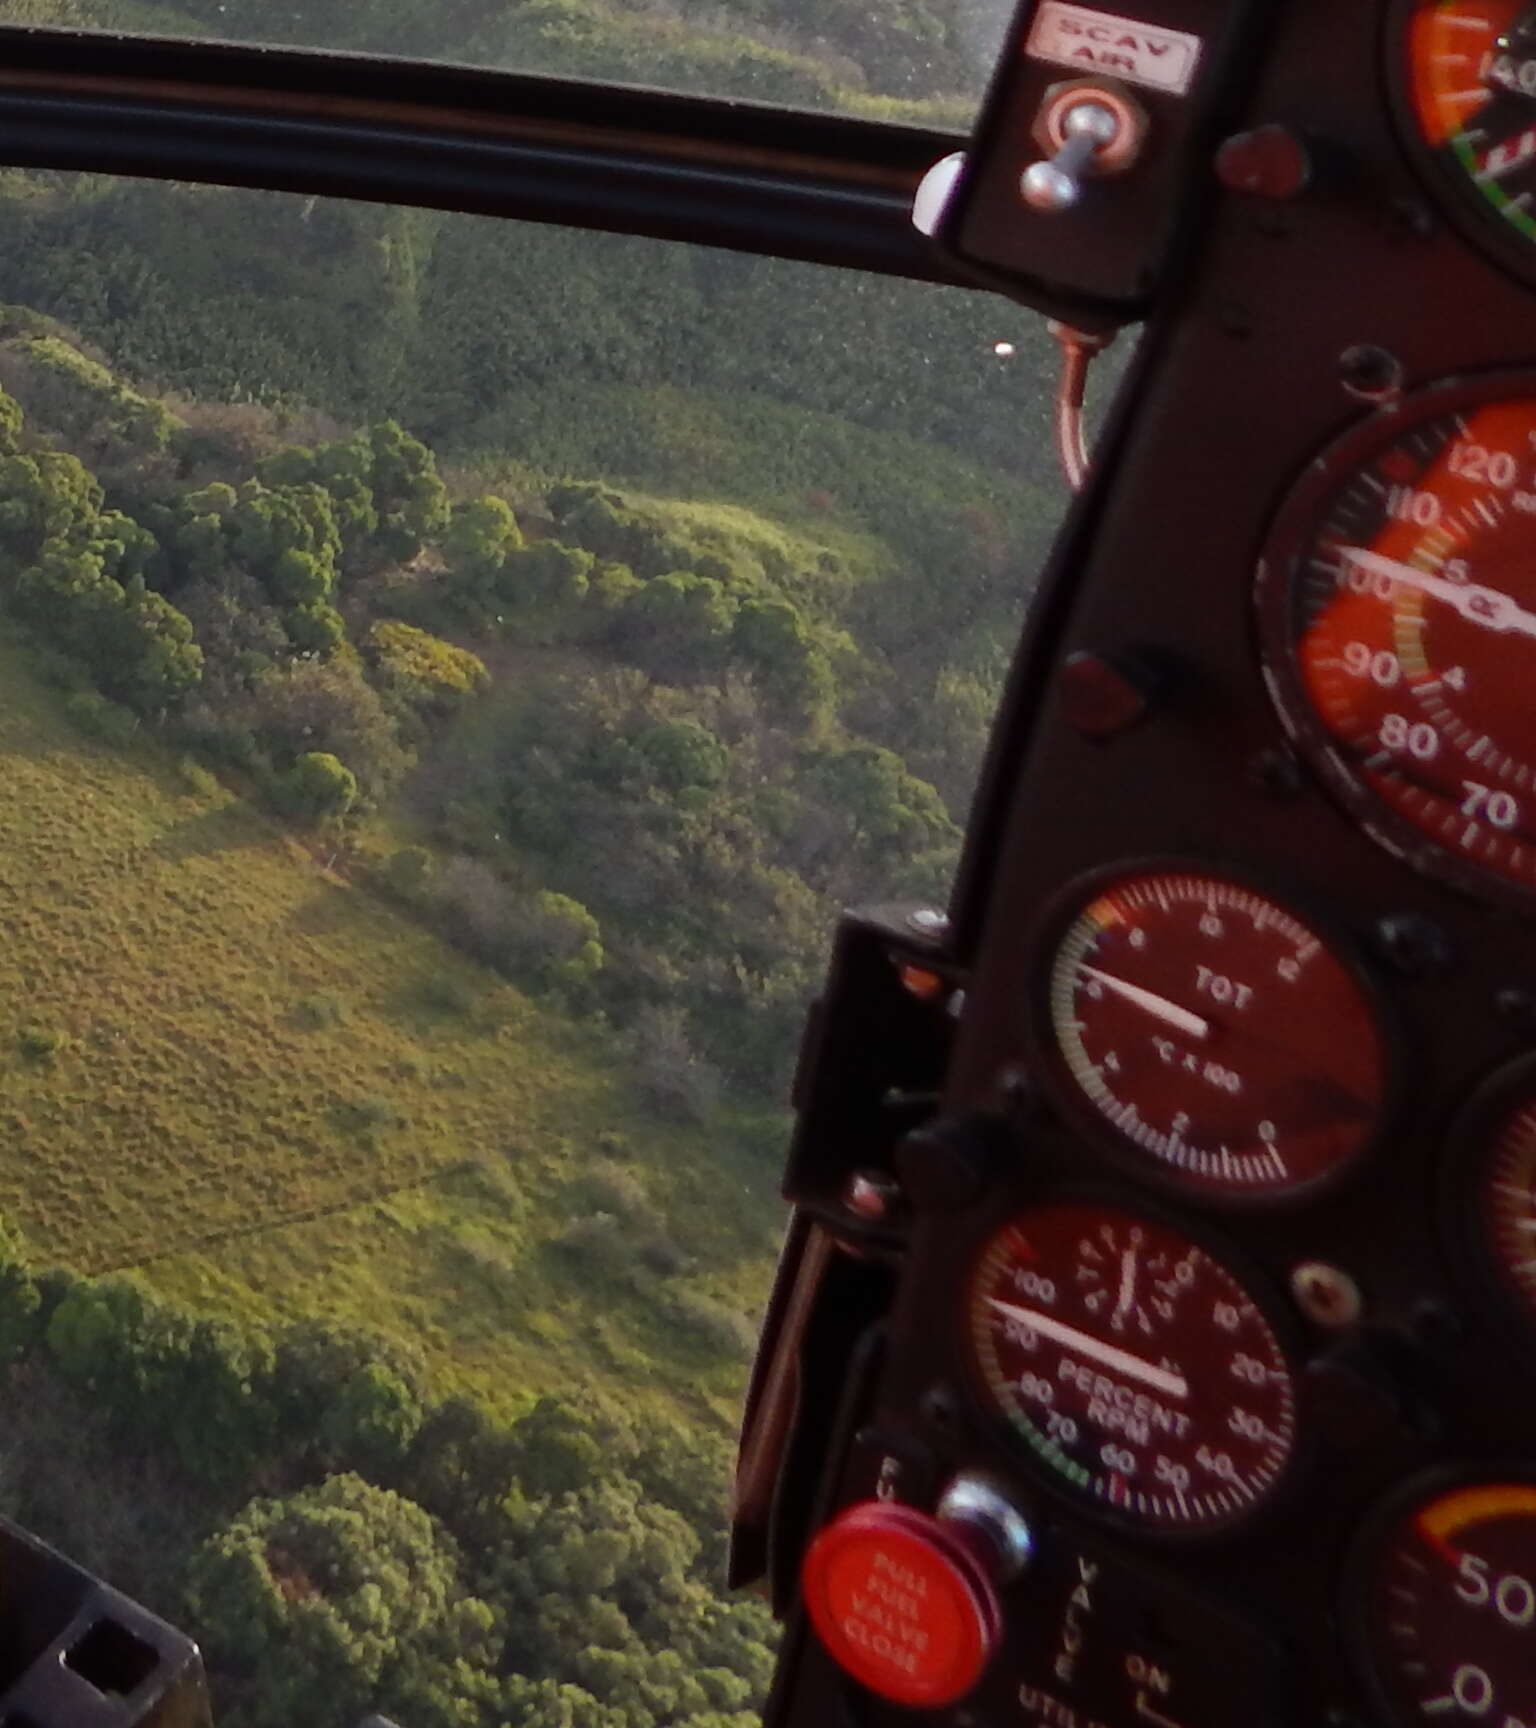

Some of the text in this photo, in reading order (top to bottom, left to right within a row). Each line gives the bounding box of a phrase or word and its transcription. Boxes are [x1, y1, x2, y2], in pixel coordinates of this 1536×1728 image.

[1058, 19, 1169, 56] SCAV
[1072, 46, 1135, 70] AIR
[1448, 440, 1516, 489] 120
[1343, 641, 1400, 688] 90
[1378, 713, 1439, 760] 80
[1459, 779, 1518, 829] 70
[1195, 964, 1254, 1010] TOT
[1013, 1266, 1057, 1304] 100
[1019, 1369, 1055, 1404] 80
[1229, 1351, 1267, 1385] 20
[1057, 1357, 1191, 1437] PERCENT
[1045, 1407, 1079, 1446] 70
[1087, 1397, 1150, 1446] RPM
[1227, 1405, 1265, 1442] 30
[1099, 1442, 1136, 1476] 60
[1454, 1553, 1536, 1627] 50
[1124, 1653, 1172, 1695] ON
[1452, 1663, 1493, 1716] 0
